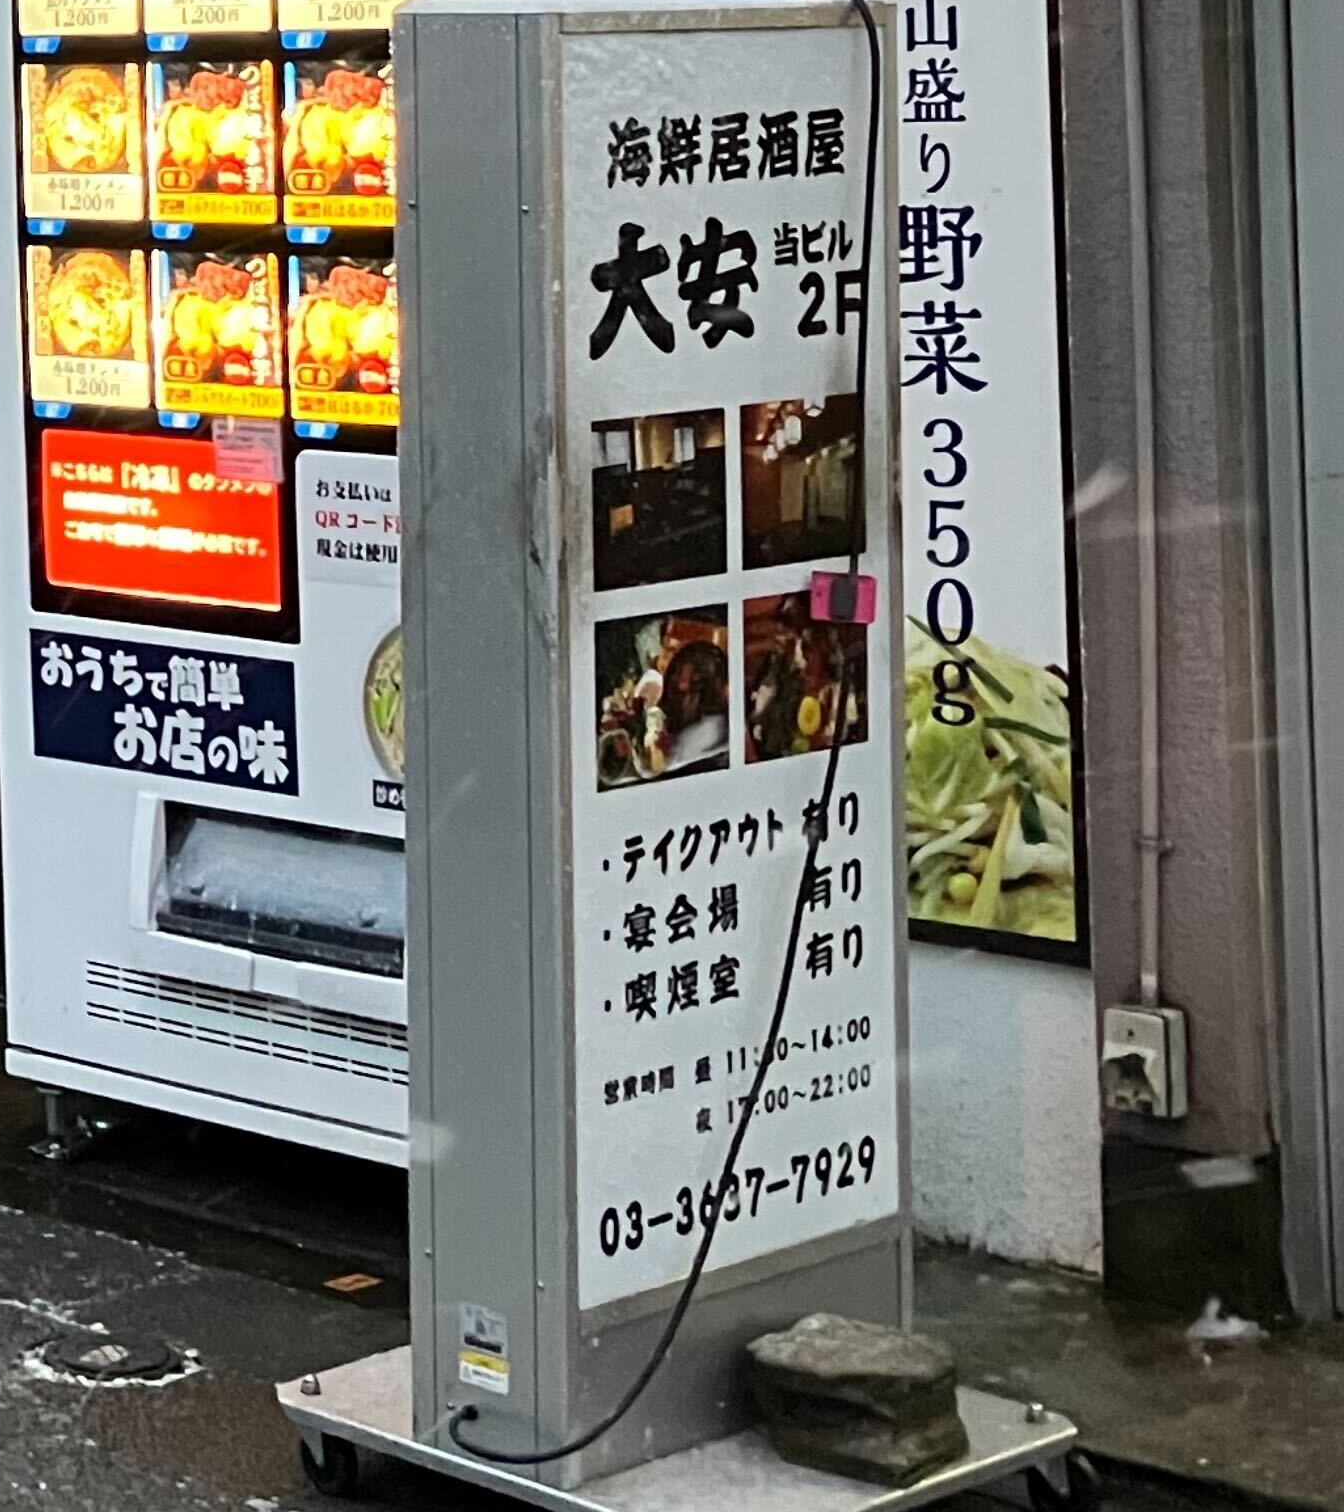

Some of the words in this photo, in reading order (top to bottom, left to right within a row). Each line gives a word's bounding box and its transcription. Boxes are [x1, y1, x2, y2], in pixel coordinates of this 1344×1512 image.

[607, 108, 845, 189] 海鮮居酒屋
[773, 220, 854, 266] 当ビル
[589, 217, 759, 361] 大安
[797, 269, 863, 338] 2F
[314, 509, 340, 530] QR
[346, 513, 402, 536] コード
[315, 479, 391, 503] お支払いは
[40, 640, 244, 711] おうちで簡単
[113, 704, 289, 785] お店の味
[805, 924, 863, 980] 有り
[726, 1016, 871, 1073] 11:0~14:00
